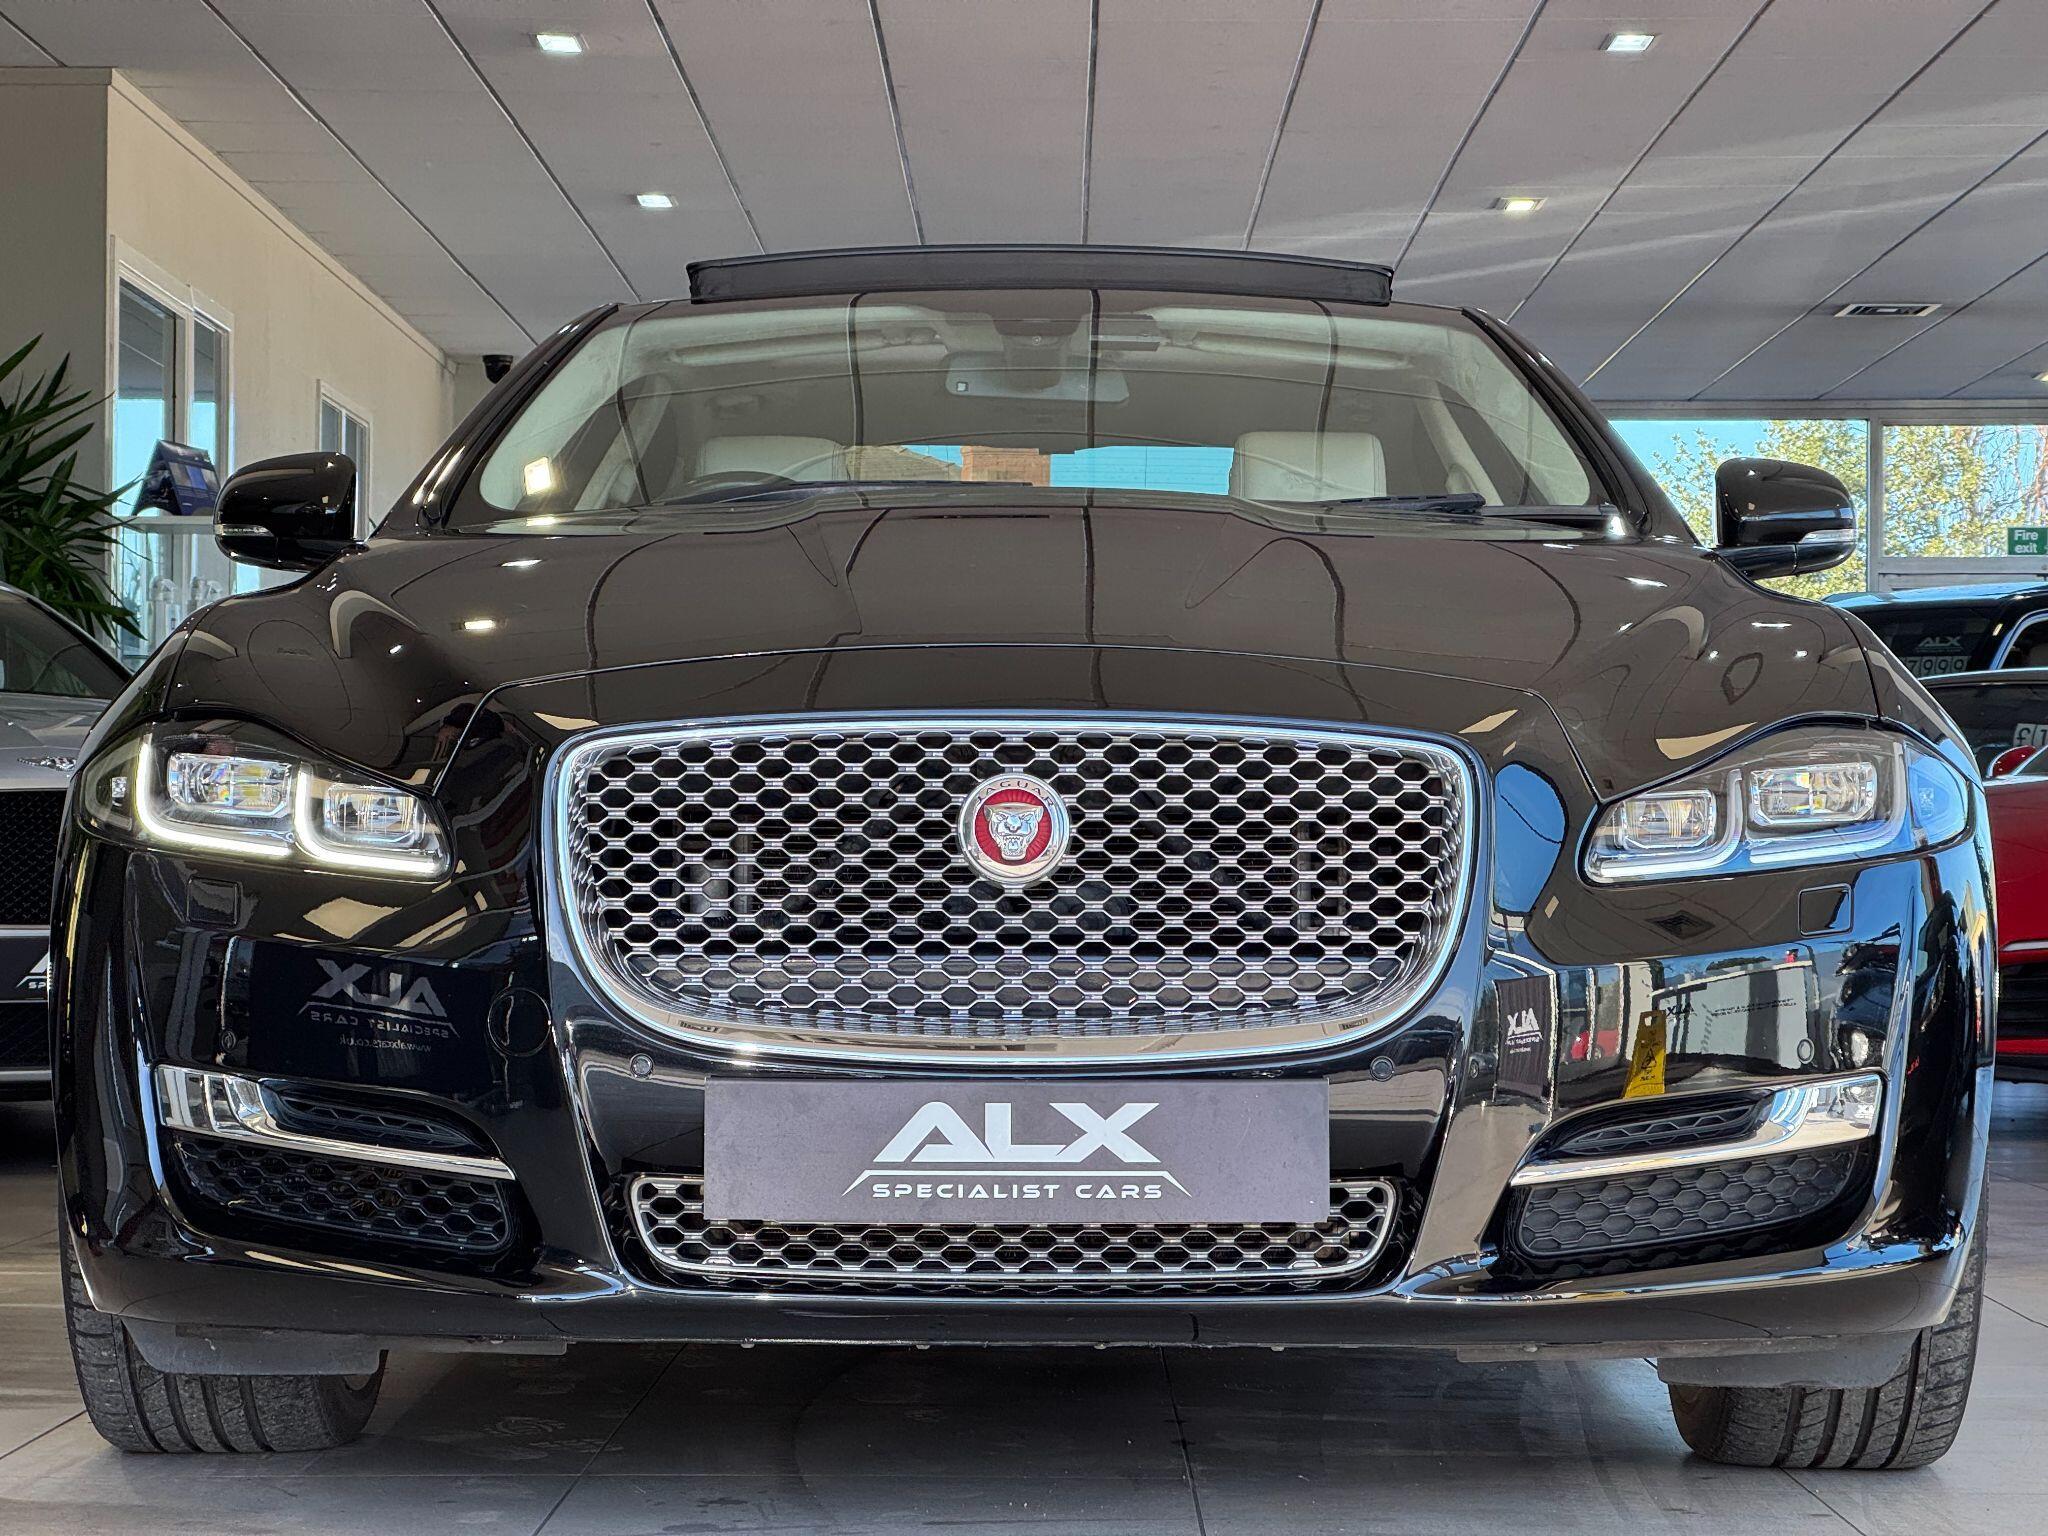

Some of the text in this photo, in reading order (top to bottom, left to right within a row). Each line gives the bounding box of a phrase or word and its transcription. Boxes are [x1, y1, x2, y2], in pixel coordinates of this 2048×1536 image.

[2014, 530, 2039, 541] Fire
[2014, 543, 2038, 554] exit
[1918, 636, 1961, 648] ALX
[976, 780, 1055, 806] JAGUAR
[873, 1101, 1163, 1164] ALX
[873, 1183, 1163, 1200] SPECIALIST CARS
